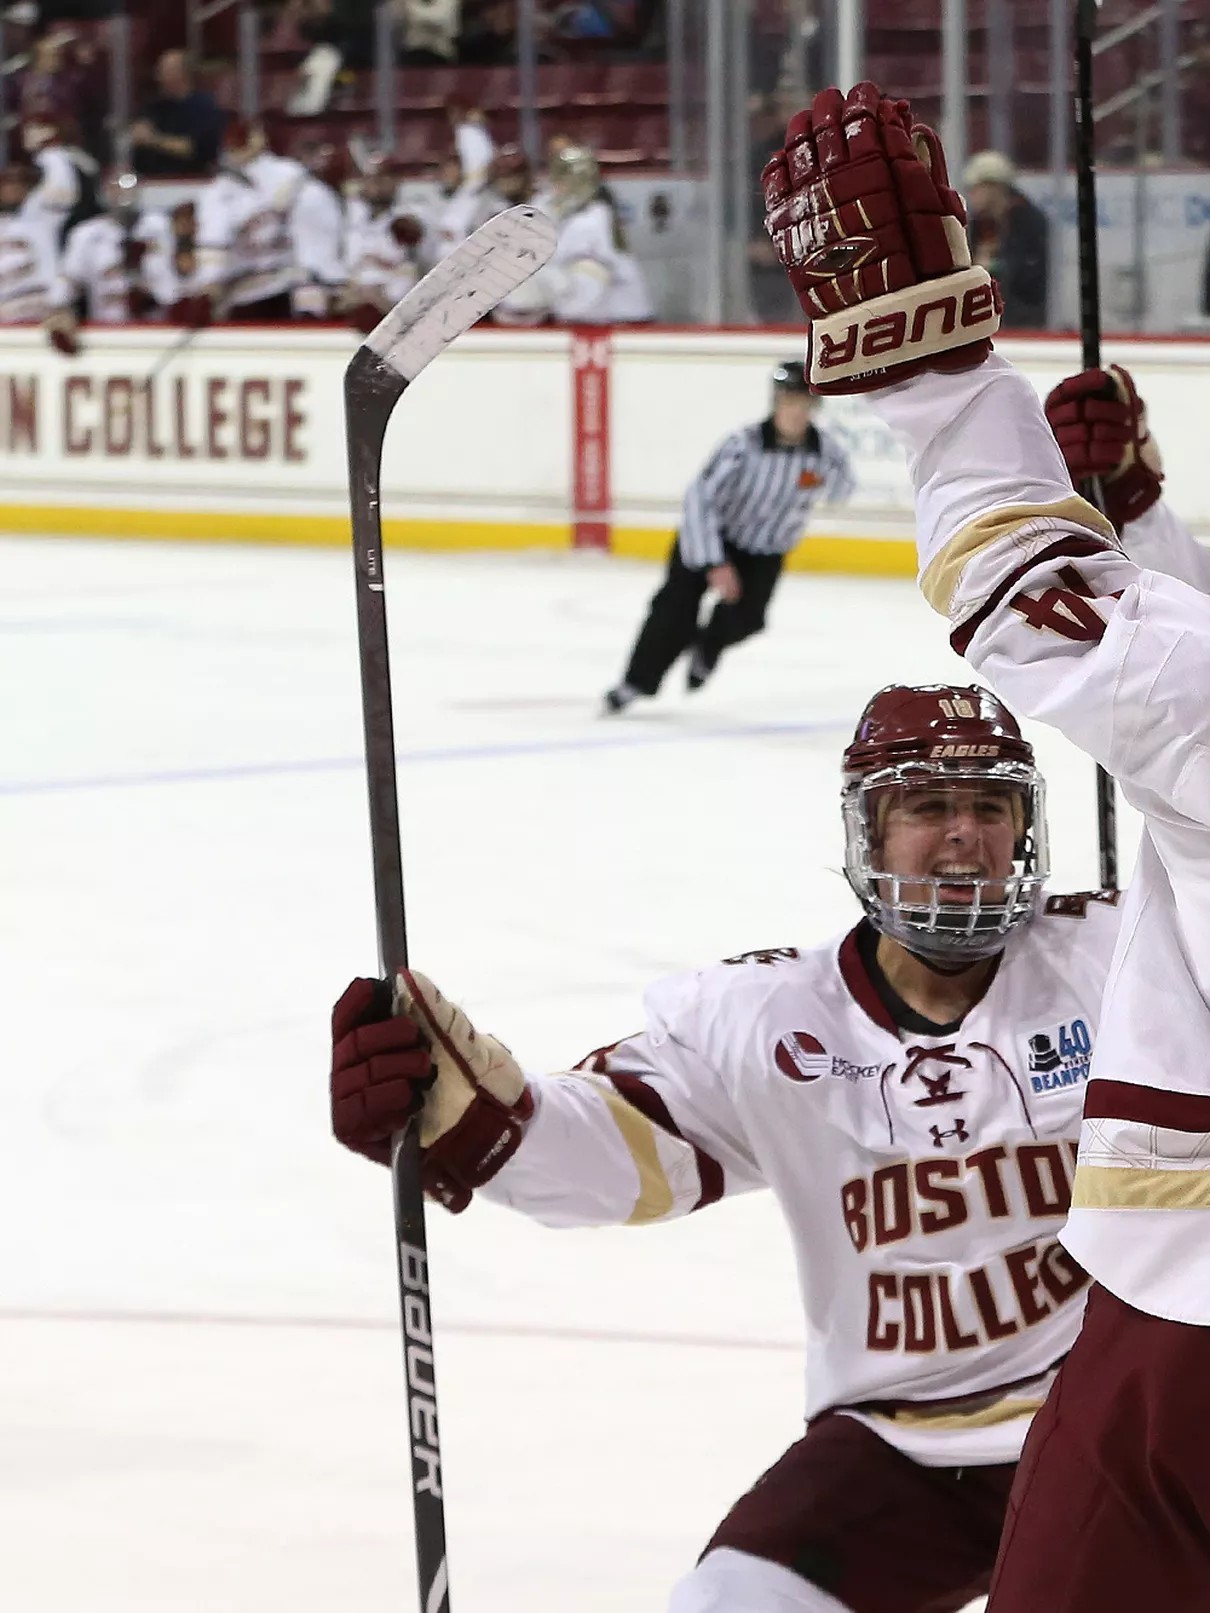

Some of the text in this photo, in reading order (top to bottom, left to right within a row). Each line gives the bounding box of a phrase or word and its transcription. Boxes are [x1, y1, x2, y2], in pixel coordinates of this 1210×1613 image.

[819, 282, 1003, 369] AUER
[64, 375, 308, 463] COLLEGE
[929, 744, 1000, 758] EAGLES
[1059, 1019, 1091, 1058] 40
[838, 1140, 1080, 1254] BOSTO
[399, 1241, 442, 1499] BAUER
